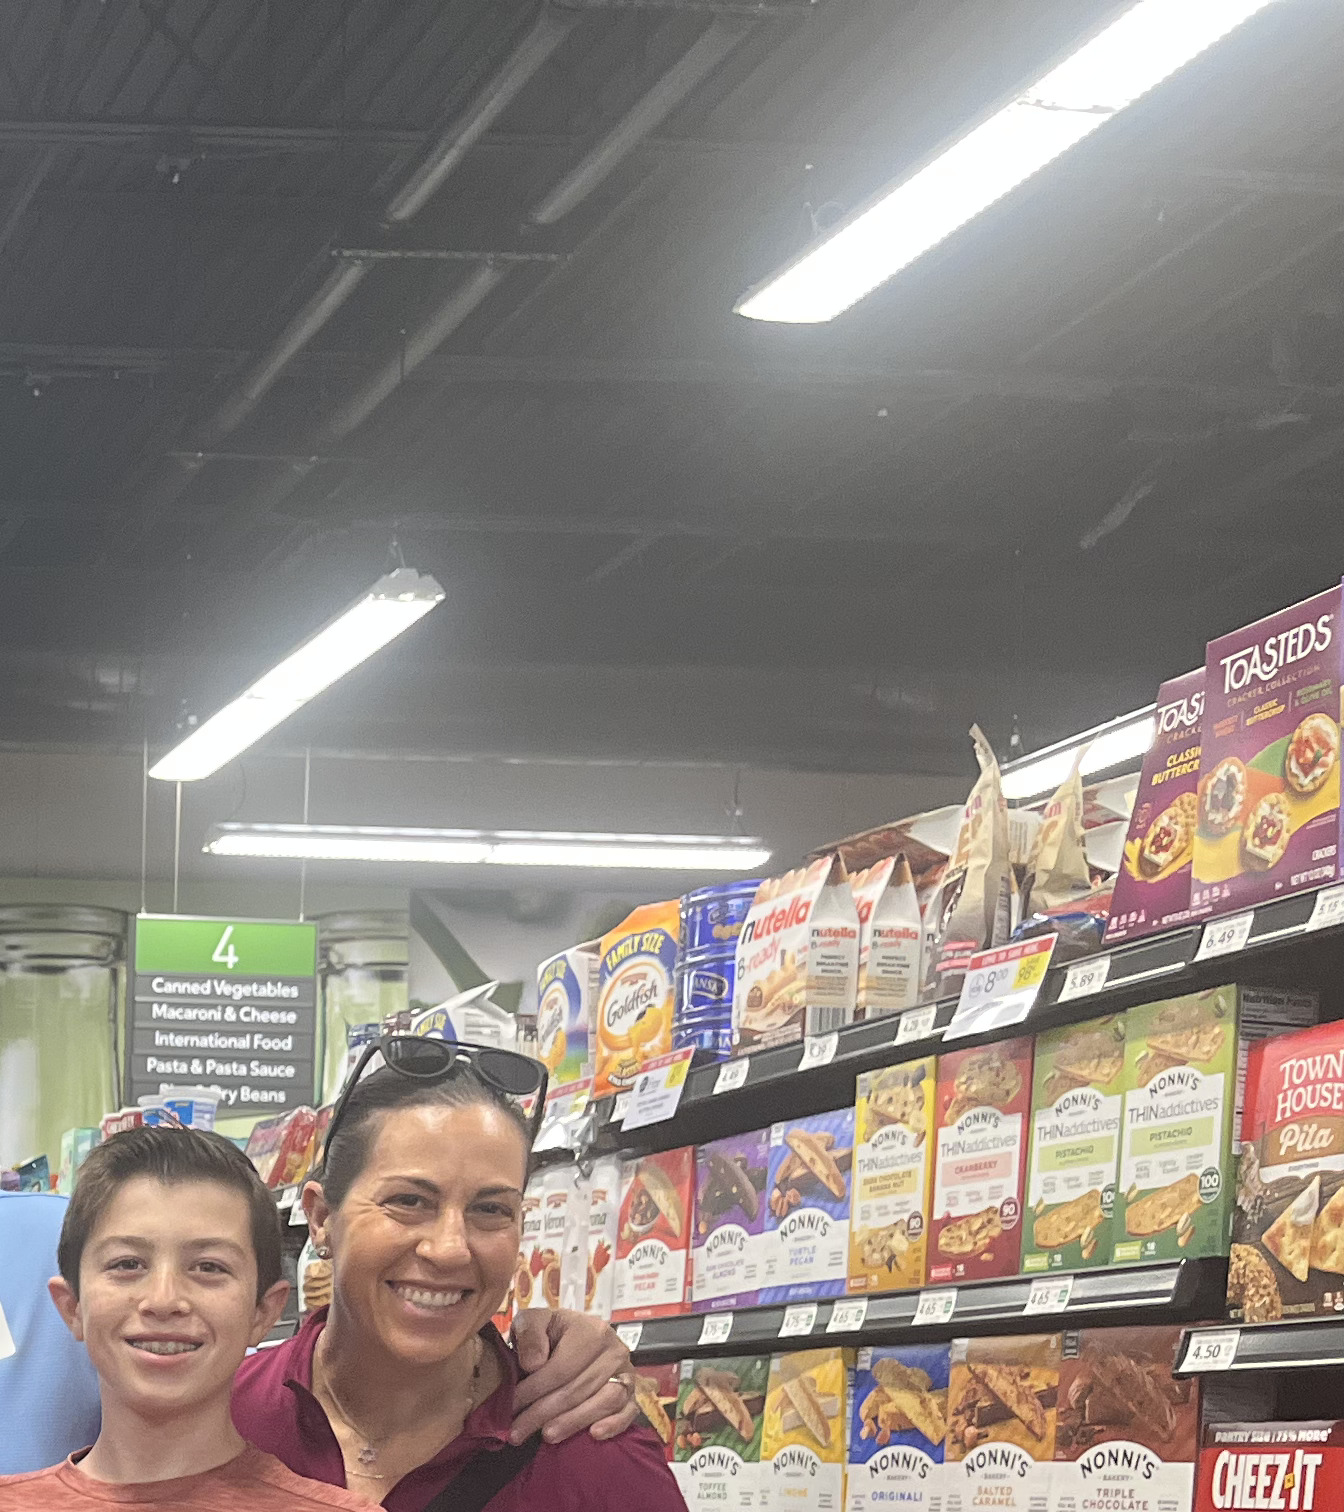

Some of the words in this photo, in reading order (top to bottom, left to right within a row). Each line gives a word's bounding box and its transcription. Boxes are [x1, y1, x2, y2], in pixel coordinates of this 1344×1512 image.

[1220, 614, 1334, 693] TOASTEDS
[743, 900, 809, 944] nutella
[812, 926, 856, 939] nutella
[873, 927, 918, 940] nutella
[212, 925, 239, 969] 4
[1206, 929, 1235, 948] 6.49
[605, 936, 639, 967] FAMILY
[151, 977, 211, 995] Canned
[213, 979, 299, 1000] Vegetables
[1070, 972, 1095, 989] 5.89
[152, 1003, 222, 1021] Macaroni
[224, 1005, 237, 1022] &
[239, 1006, 297, 1024] Cheese
[606, 980, 657, 1024] Goldfish
[155, 1030, 251, 1049] International
[253, 1033, 293, 1051] Food
[147, 1057, 188, 1074] Pasta
[190, 1058, 203, 1075] &
[206, 1059, 247, 1076] Pasta
[250, 1060, 295, 1078] Sauce
[1280, 1051, 1344, 1090] TOWN
[240, 1086, 286, 1103] Beans
[1149, 1075, 1200, 1098] NONNI'S
[1055, 1093, 1100, 1116] NONNI'S
[1276, 1082, 1344, 1121] HOUSE
[958, 1113, 1000, 1134] NONNI'S
[1150, 1127, 1193, 1141] PISTACHIO
[1279, 1124, 1335, 1156] Pita
[779, 1215, 832, 1243] NONNI'S
[706, 1231, 746, 1254] NONNI'S
[628, 1246, 668, 1268] NONNI'S
[1193, 1344, 1221, 1360] 4.50
[689, 1454, 740, 1476] NONNI'S
[773, 1452, 817, 1477] NONNI'S
[869, 1455, 930, 1479] NONNI'S
[966, 1452, 1028, 1478] NONNI'S
[1080, 1452, 1157, 1479] NONNI'S
[1096, 1488, 1135, 1498] TRIPLE
[1082, 1500, 1149, 1511] CHOCOLATE
